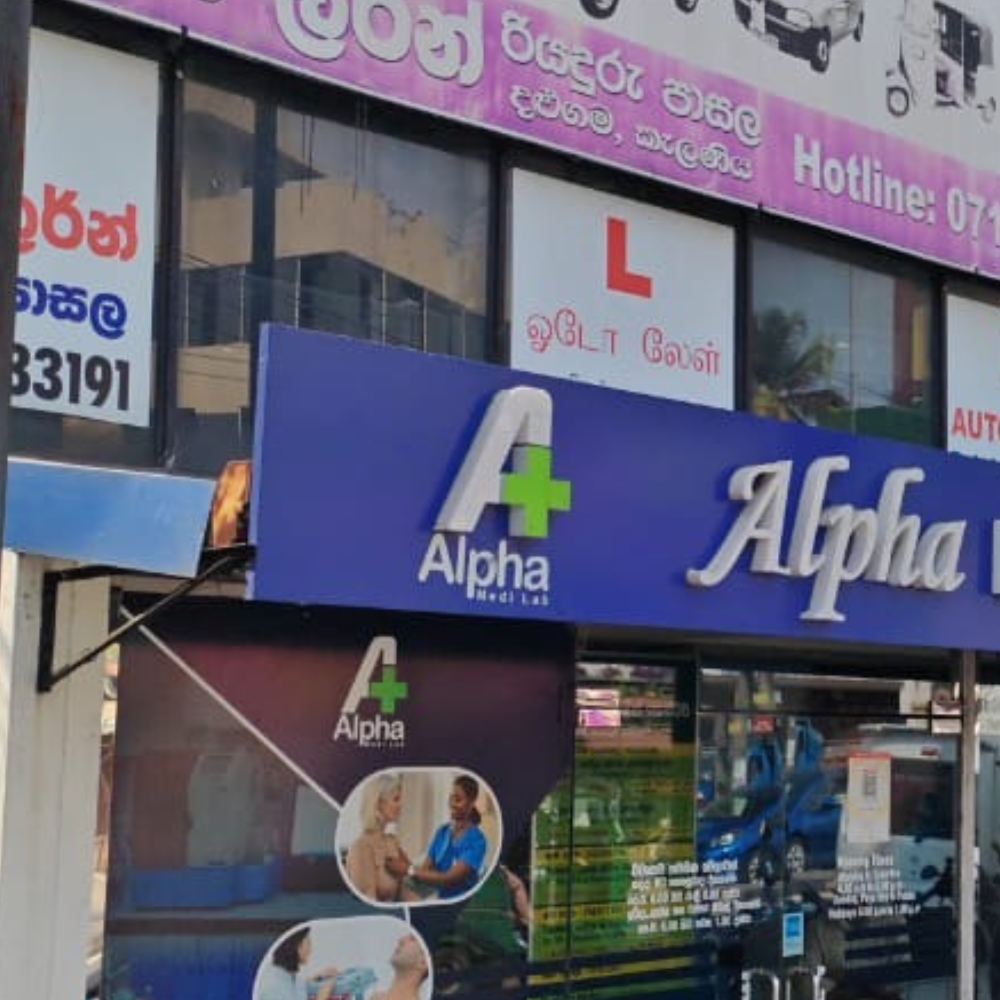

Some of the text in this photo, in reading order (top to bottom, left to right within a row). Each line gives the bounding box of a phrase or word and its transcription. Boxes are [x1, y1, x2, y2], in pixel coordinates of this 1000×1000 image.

[662, 78, 763, 146] පාසල
[793, 133, 937, 225] Hotline:
[606, 216, 653, 299] L
[418, 532, 549, 599] Alpha
[686, 454, 968, 623] Alpha
[333, 712, 406, 747] Alpha
